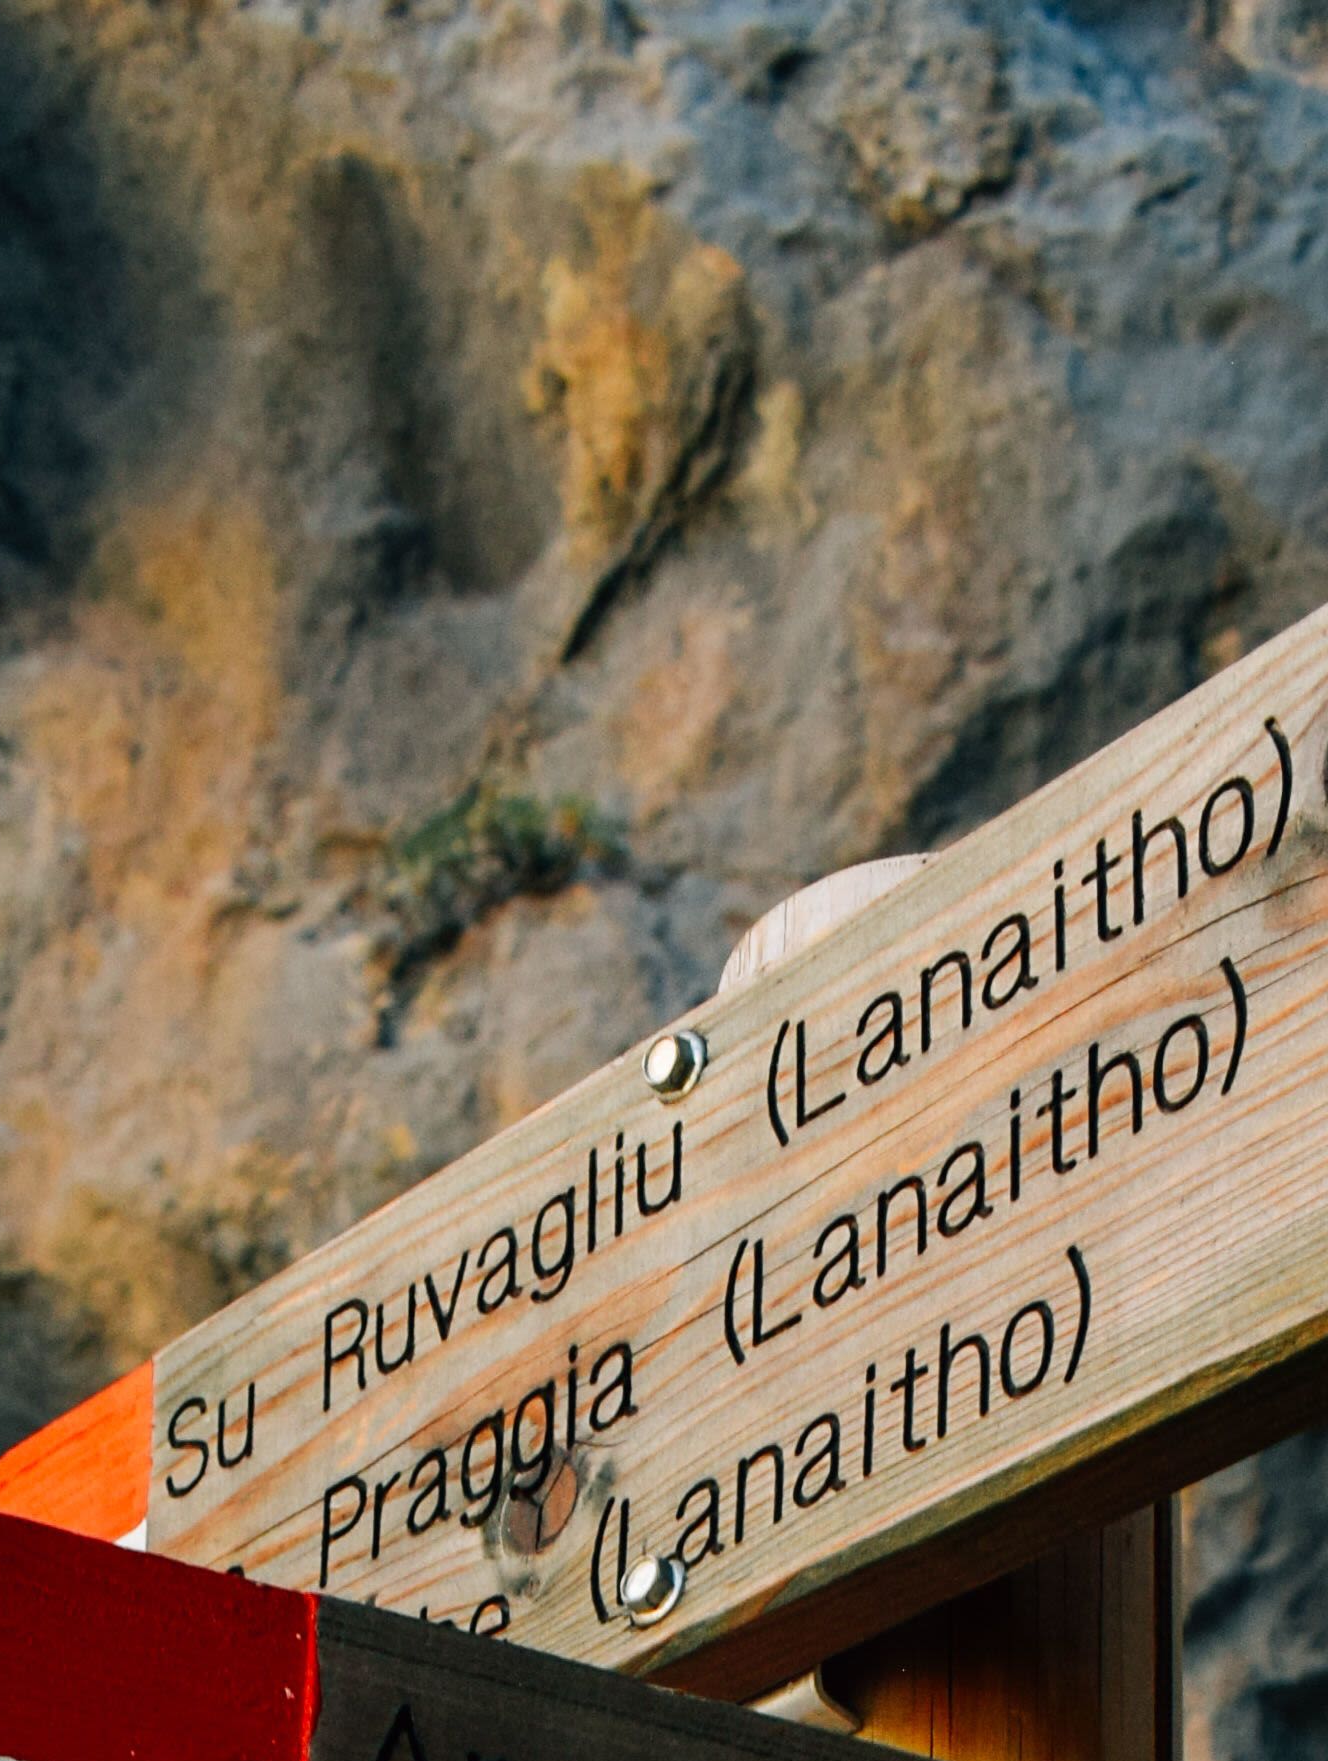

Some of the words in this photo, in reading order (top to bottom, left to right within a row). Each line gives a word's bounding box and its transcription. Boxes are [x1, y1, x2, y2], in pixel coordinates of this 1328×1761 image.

[167, 1383, 255, 1498] Su
[323, 1121, 683, 1412] Ruvagliu
[767, 717, 1292, 1146] (Lanaitho)
[320, 1342, 638, 1588] Praggia
[725, 957, 1247, 1366] (Lanaitho)
[590, 1245, 1091, 1623] (Lanaitho)
